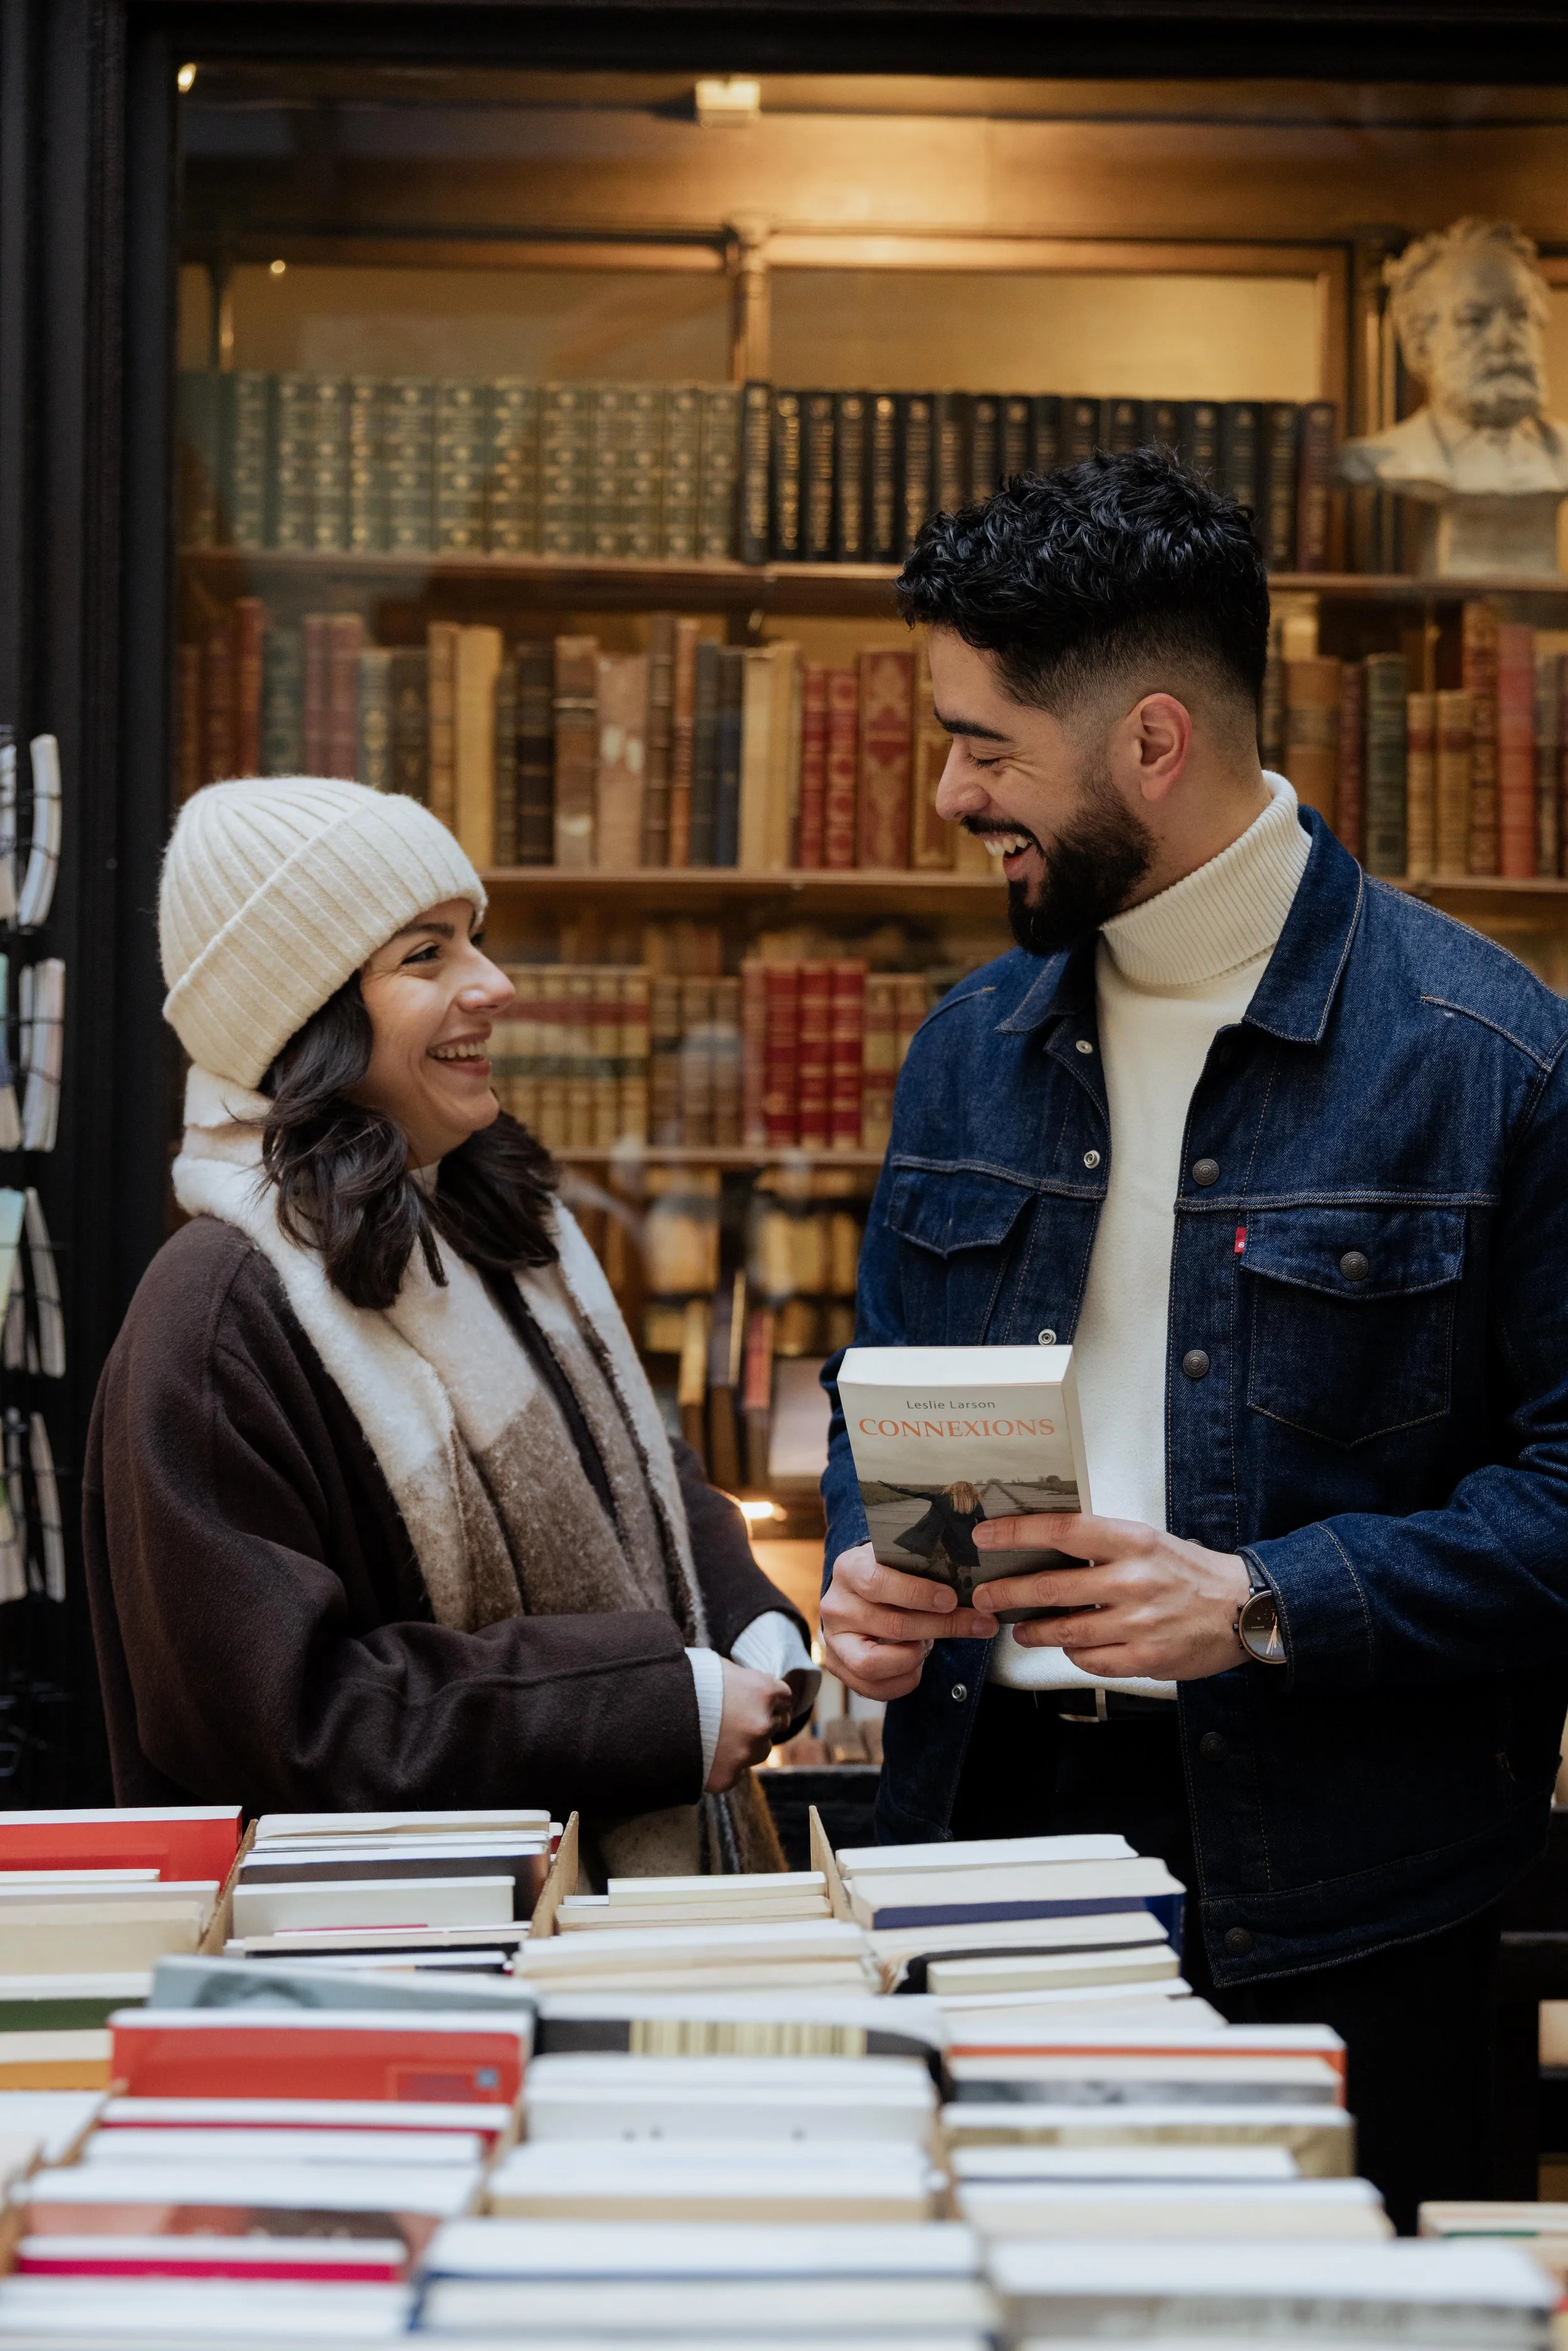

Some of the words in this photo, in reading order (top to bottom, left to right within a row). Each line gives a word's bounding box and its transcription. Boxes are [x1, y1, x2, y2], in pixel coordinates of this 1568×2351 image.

[907, 1400, 945, 1409] Leslie
[950, 1400, 995, 1409] Larson
[859, 1418, 1055, 1437] CONNEXIONS
